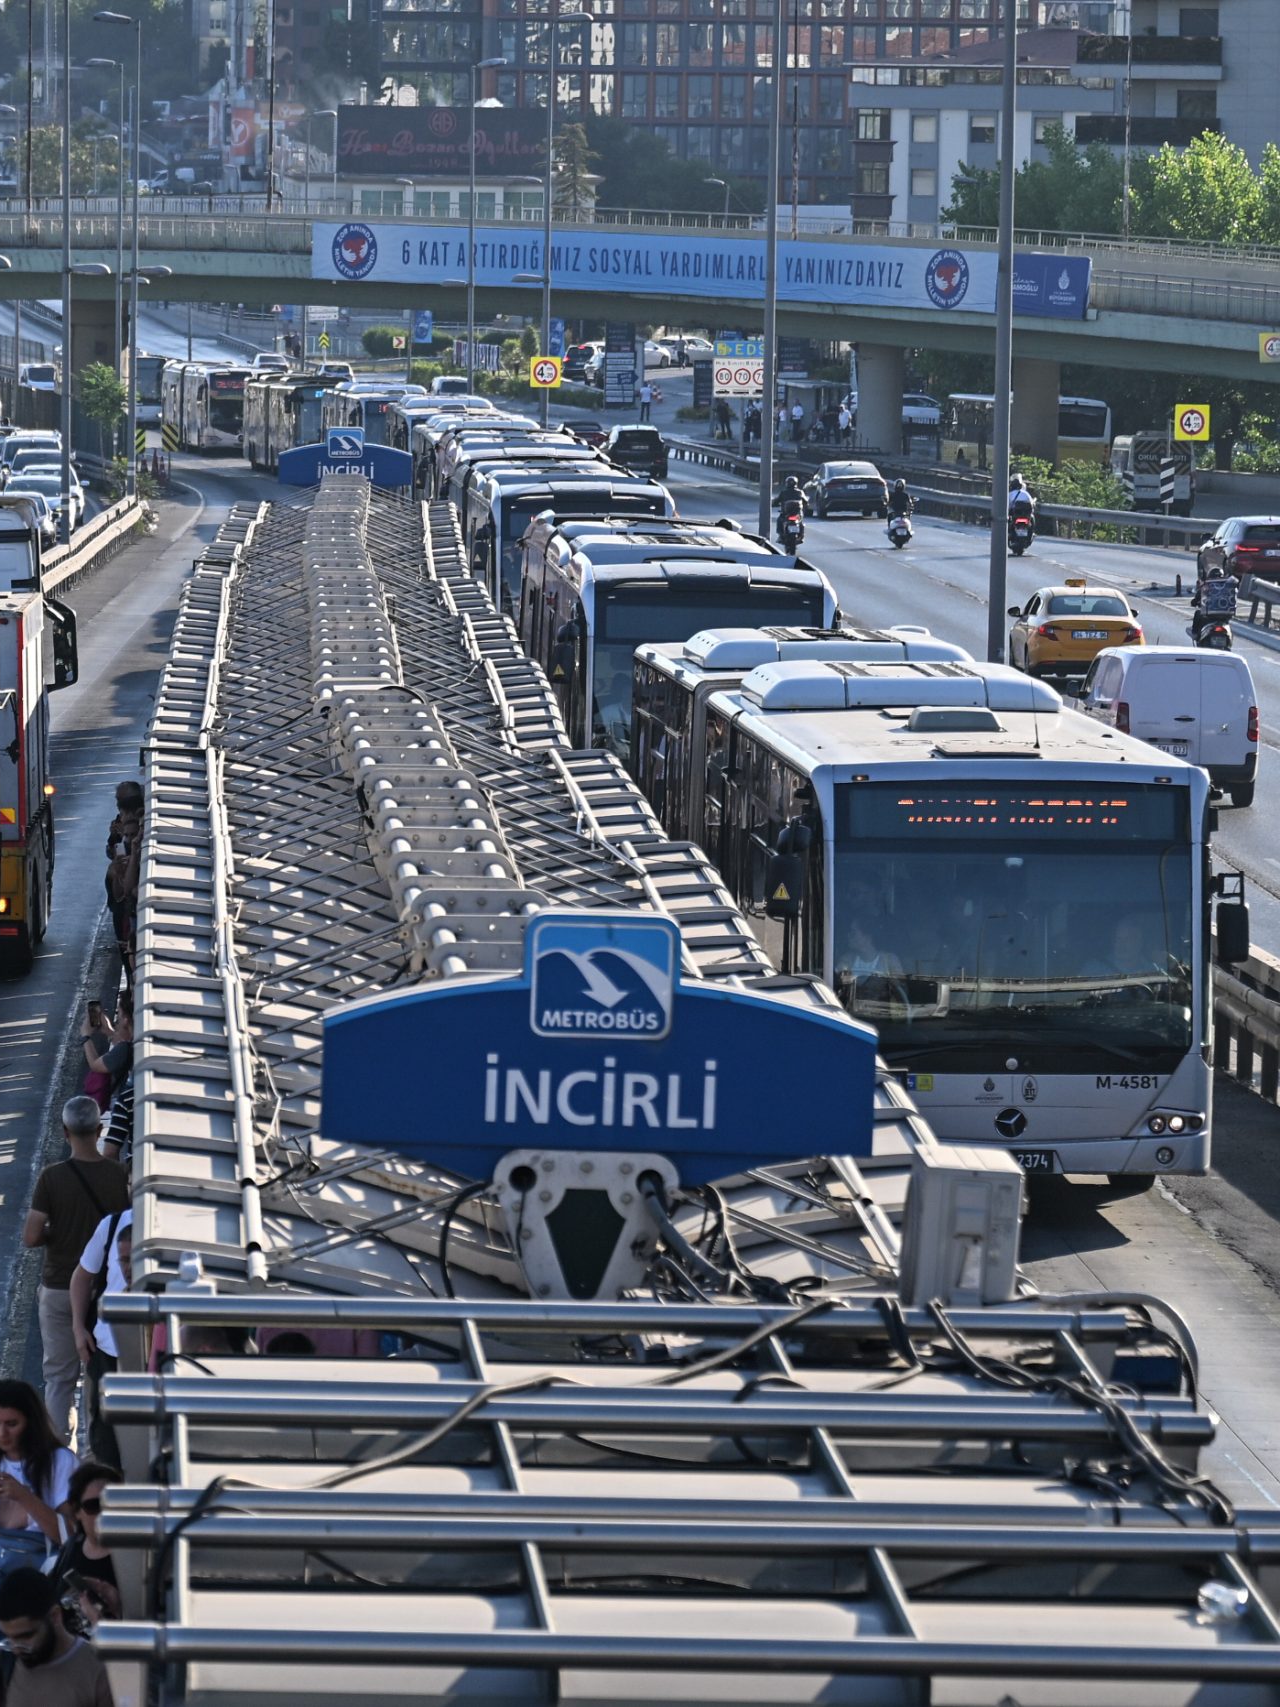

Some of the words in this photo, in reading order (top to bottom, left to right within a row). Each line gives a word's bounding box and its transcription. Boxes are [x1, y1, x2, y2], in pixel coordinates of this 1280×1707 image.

[402, 239, 411, 265] 6
[419, 241, 450, 266] KAT
[588, 246, 653, 276] SOSYAL
[786, 257, 904, 288] YANINIZDAYIZ
[719, 371, 729, 381] 80
[738, 371, 748, 381] 70
[542, 1009, 659, 1030] METROBÜS
[1096, 1075, 1158, 1090] M-4581
[484, 1053, 717, 1129] İNCİRLİ
[1017, 1154, 1048, 1169] 2374
